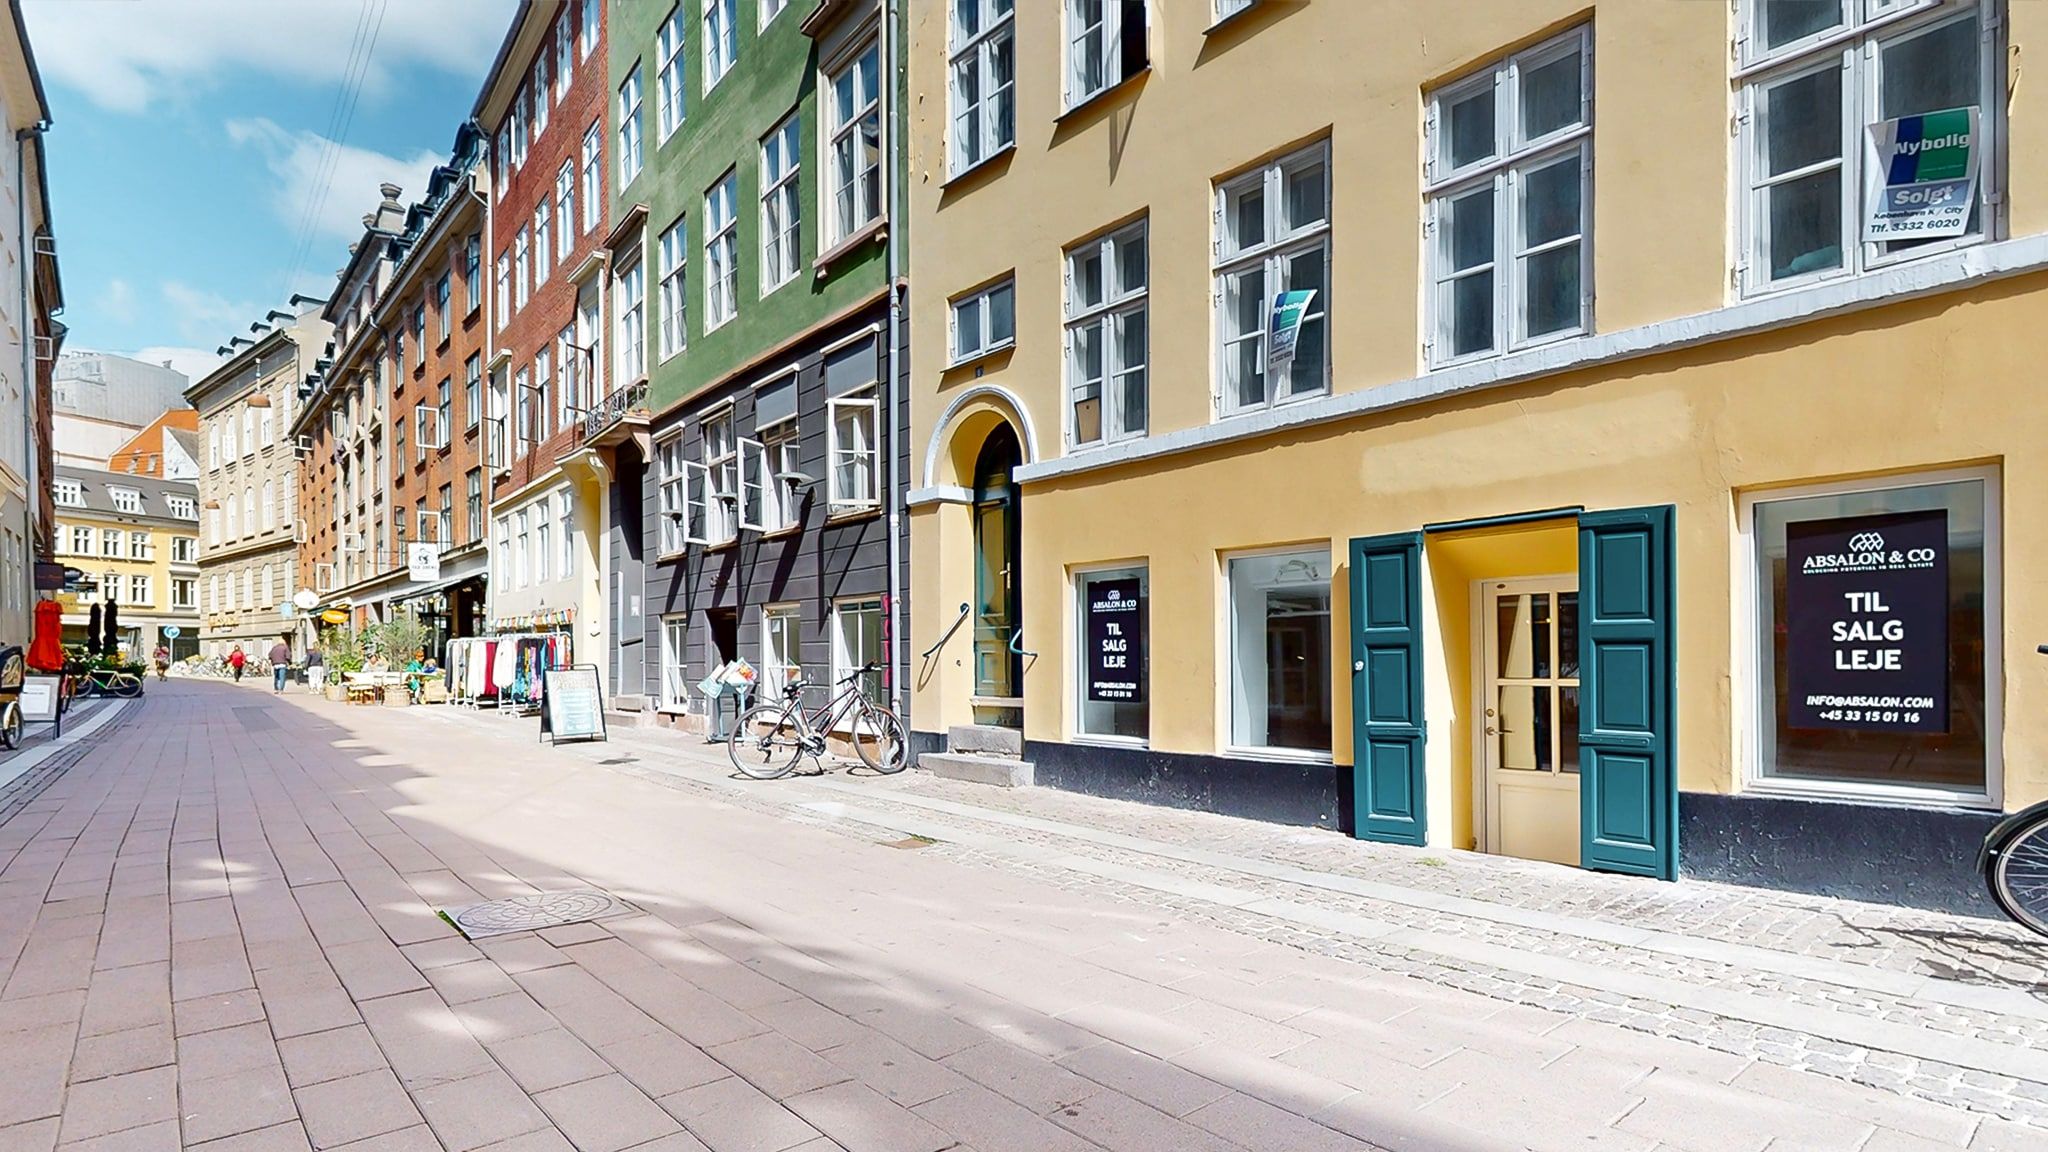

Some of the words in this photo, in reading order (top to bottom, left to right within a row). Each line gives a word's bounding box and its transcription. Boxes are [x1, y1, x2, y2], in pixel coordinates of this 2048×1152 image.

[1894, 133, 1970, 156] Nybolig
[1894, 185, 1954, 205] Solgt
[1944, 206, 1964, 216] City
[1891, 221, 1924, 232] 3332
[1927, 218, 1960, 229] 6020
[1803, 551, 1886, 569] ABSALON
[1888, 550, 1904, 564] &
[1907, 548, 1936, 562] CO
[1127, 599, 1137, 607] CO
[1844, 591, 1890, 613] TIL
[1106, 622, 1122, 636] TIL
[1832, 620, 1904, 642] SALG
[1102, 639, 1127, 652] SALG
[1103, 655, 1127, 668] LEJE
[1834, 649, 1902, 671] LEJE
[1806, 694, 1934, 709] INFO@ABSALON.COM
[1819, 710, 1843, 721] +45
[1844, 710, 1861, 722] 33
[1864, 711, 1881, 722] 15
[1882, 711, 1899, 723] 01
[1904, 712, 1920, 724] 16
